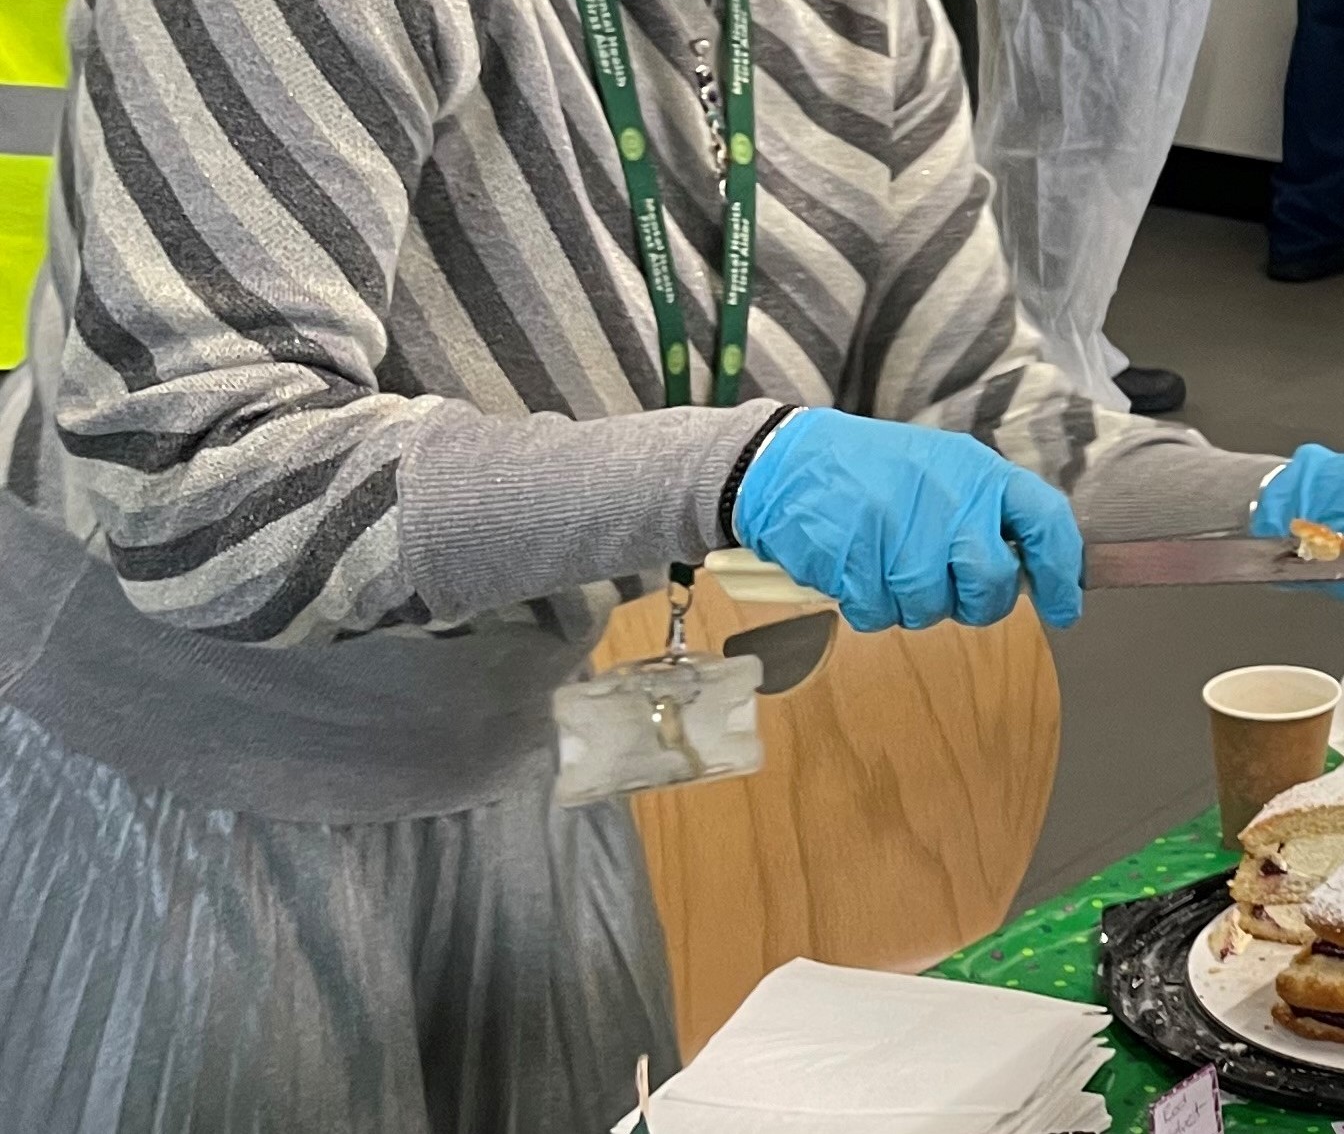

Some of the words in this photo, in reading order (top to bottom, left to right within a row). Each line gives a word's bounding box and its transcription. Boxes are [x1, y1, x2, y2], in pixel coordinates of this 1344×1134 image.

[593, 34, 612, 75] Aider
[605, 36, 627, 88] Health
[731, 44, 743, 95] Mental
[645, 198, 665, 251] Mental
[658, 253, 675, 304] Health
[730, 201, 742, 250] Health
[738, 218, 750, 257] Aider
[638, 215, 655, 249] First
[648, 253, 664, 292] Aider
[737, 261, 749, 293] First
[727, 253, 740, 306] Mental
